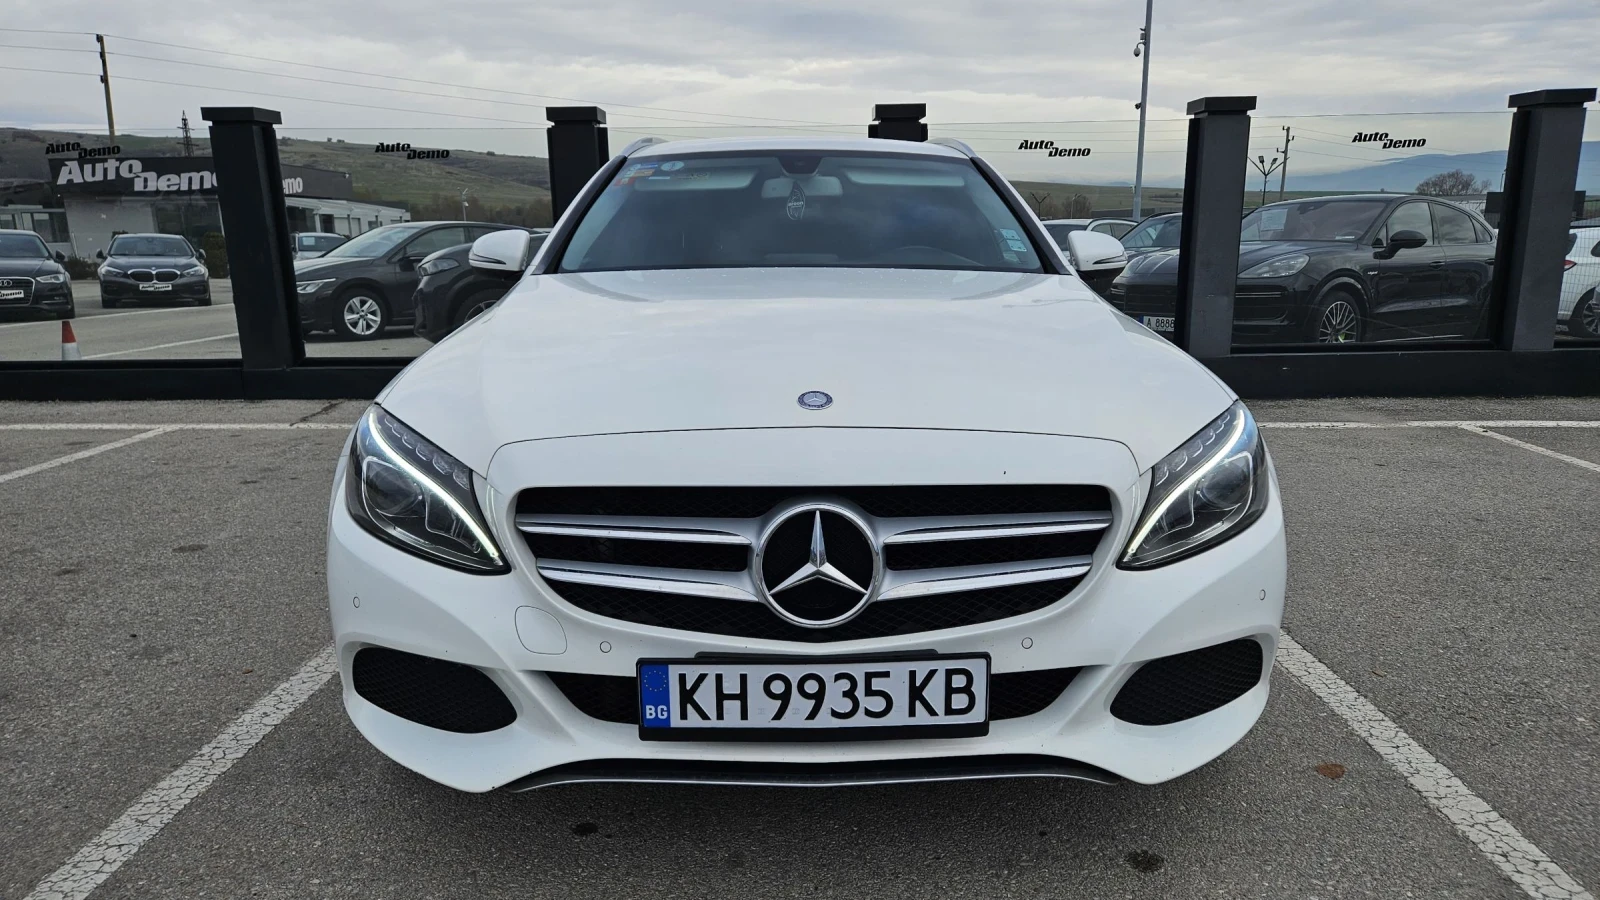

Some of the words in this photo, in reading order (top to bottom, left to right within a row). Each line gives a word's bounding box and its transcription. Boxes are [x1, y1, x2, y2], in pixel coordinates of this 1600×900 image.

[1018, 140, 1054, 150] Auto
[1048, 147, 1091, 157] Demo
[1352, 132, 1389, 143] Auto
[1382, 138, 1427, 149] Demo
[45, 142, 81, 155] Auto
[78, 145, 121, 159] Demo
[375, 142, 411, 153] Auto
[407, 149, 450, 160] Demo
[56, 158, 143, 185] Auto
[677, 672, 749, 721] KH
[762, 670, 894, 721] 9935
[907, 667, 977, 718] KB
[645, 704, 669, 720] BG
